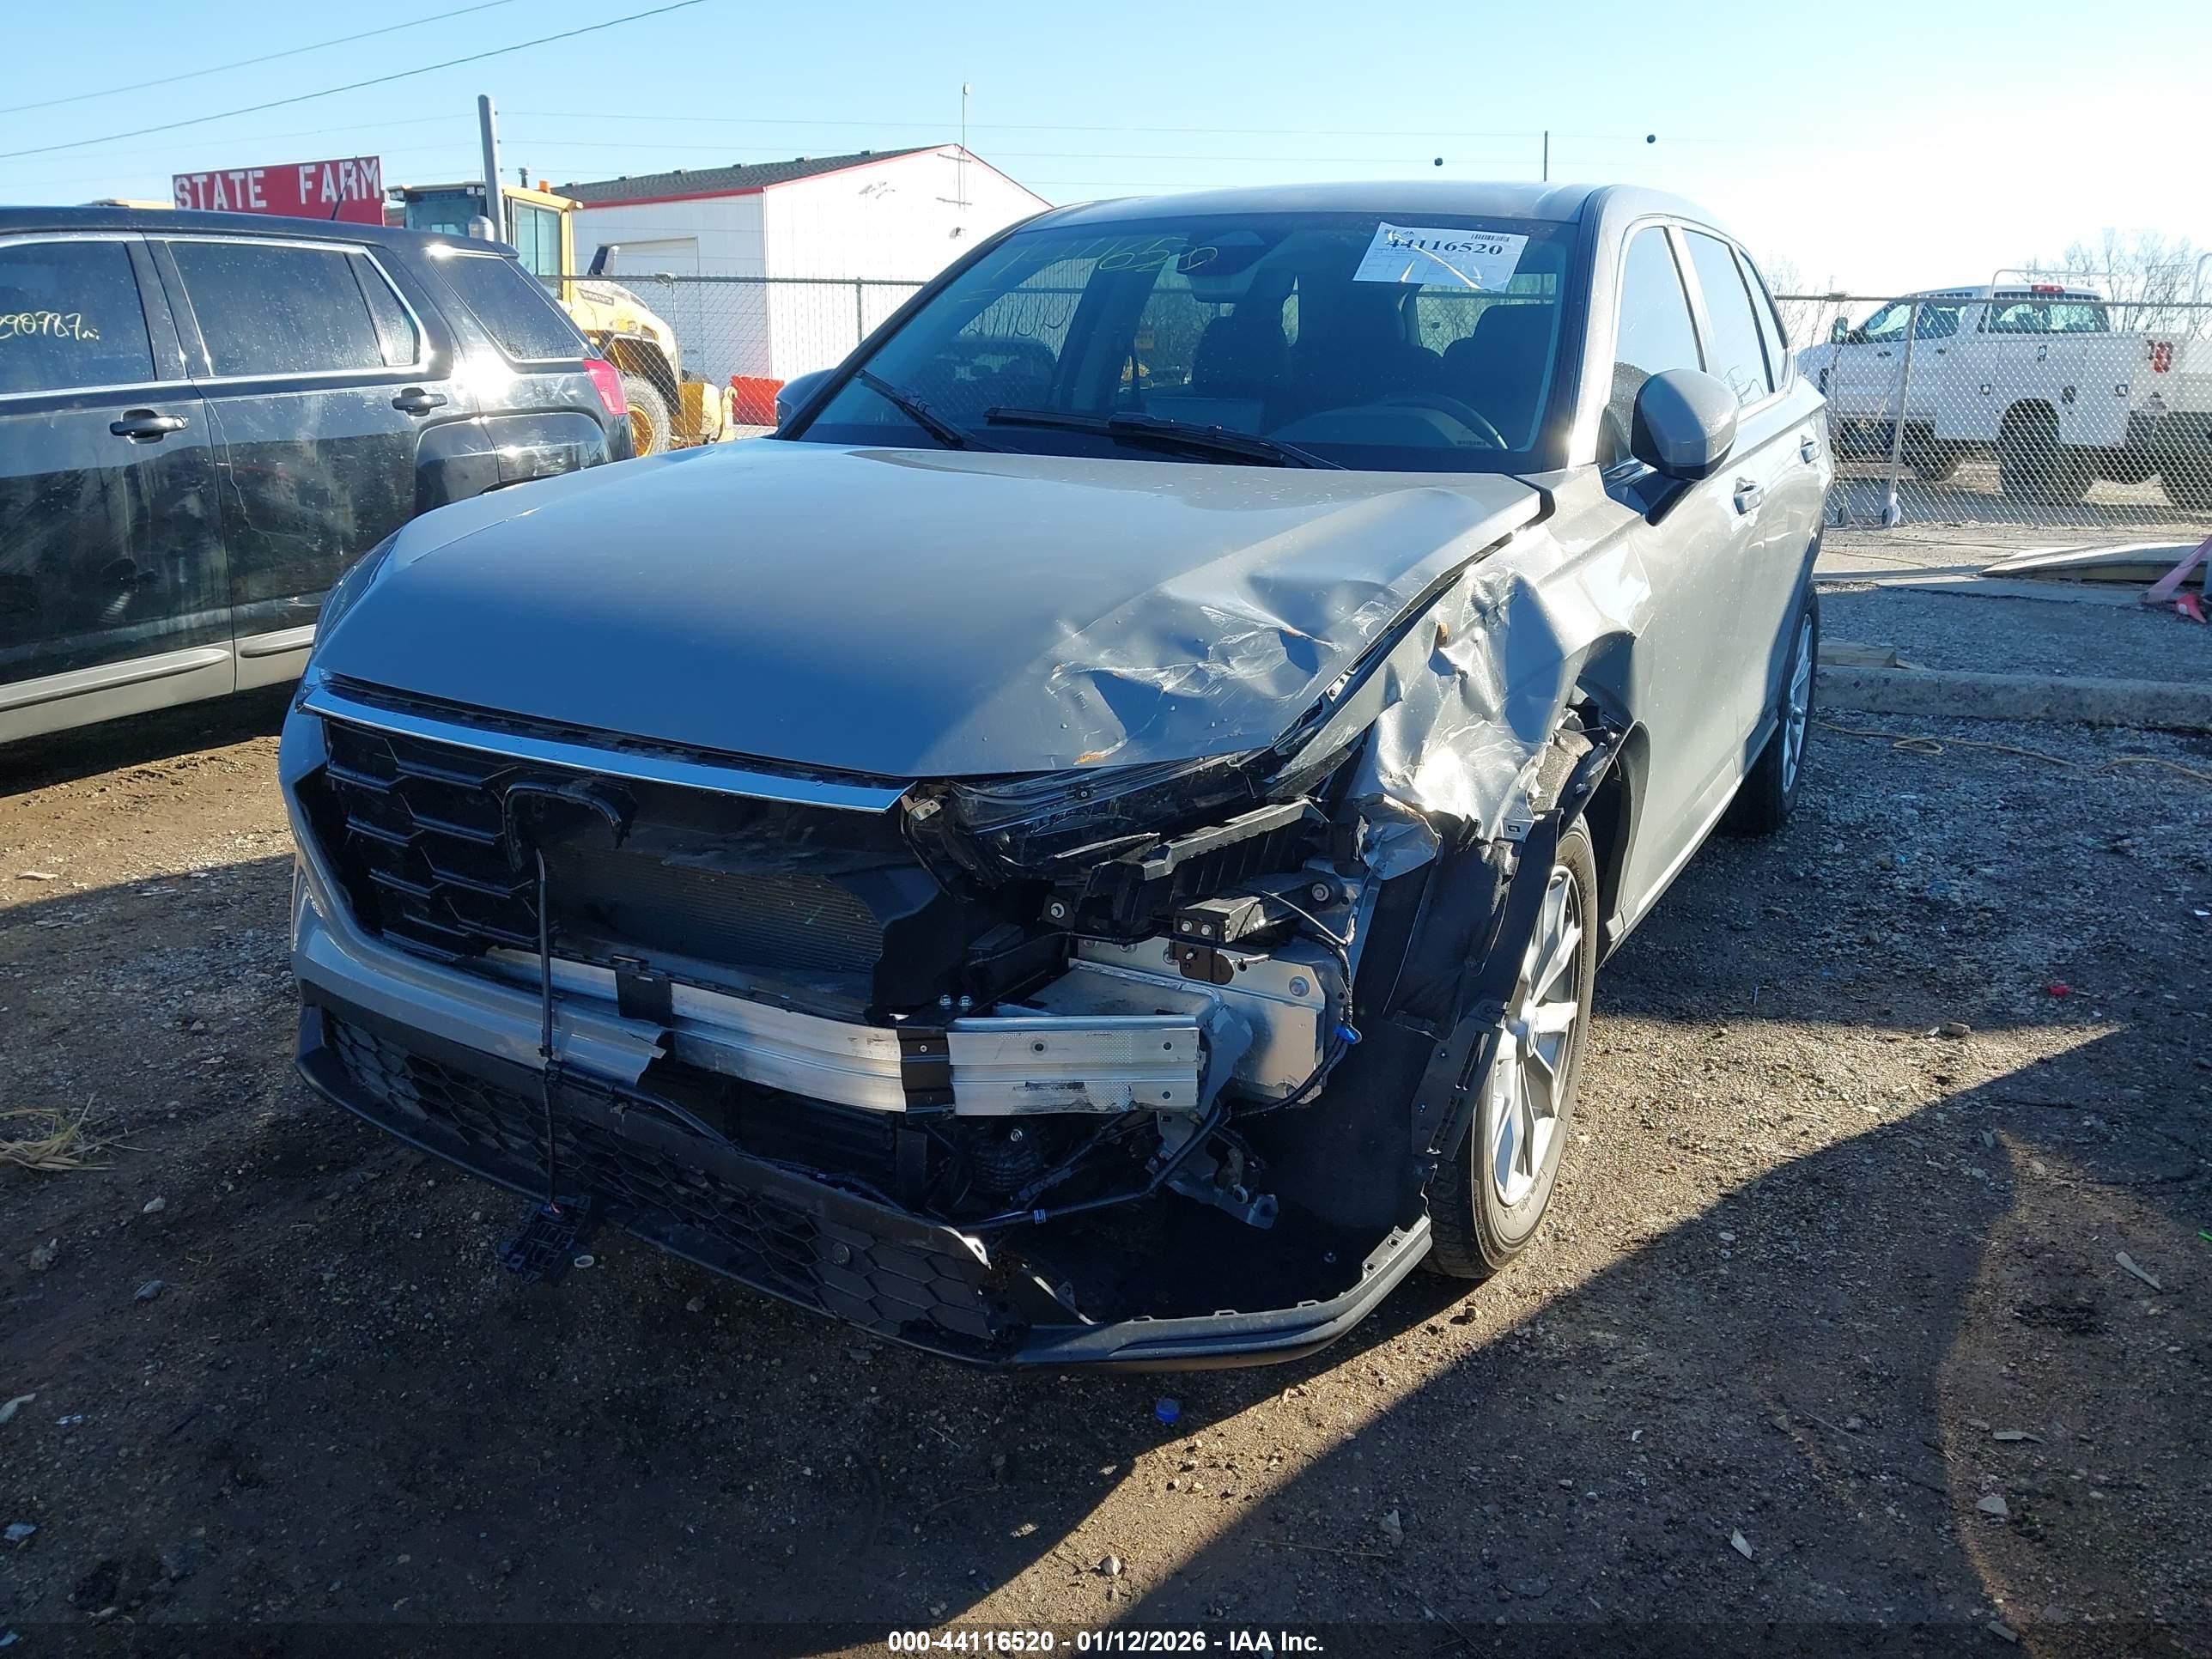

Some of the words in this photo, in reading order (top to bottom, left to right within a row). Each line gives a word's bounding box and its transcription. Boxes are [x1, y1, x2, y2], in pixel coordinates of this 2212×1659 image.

[173, 170, 267, 211] STATE
[298, 159, 380, 204] FARM
[1385, 238, 1504, 256] 44116520
